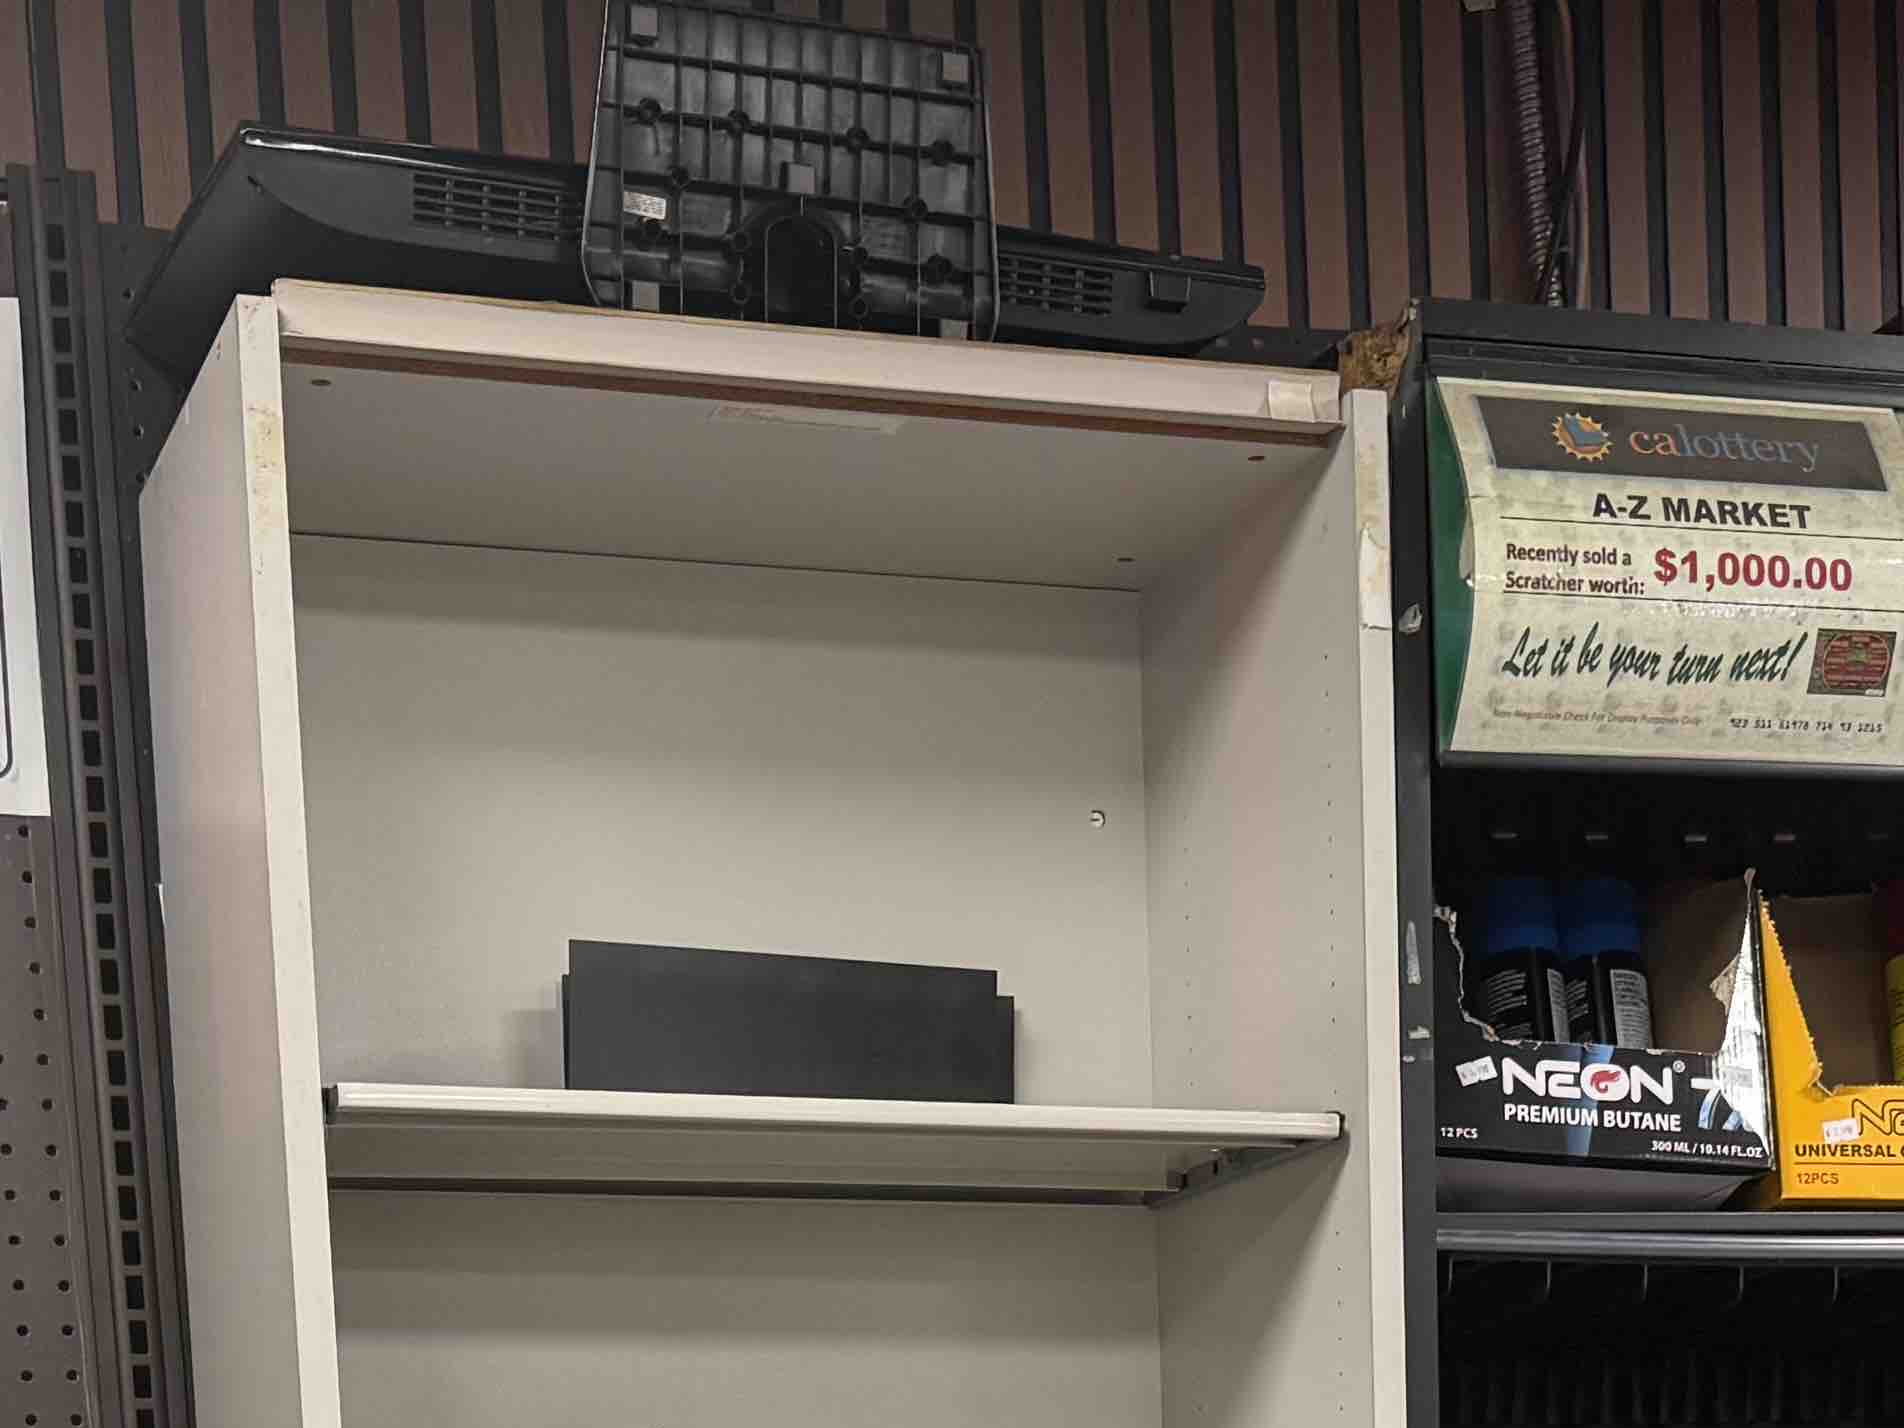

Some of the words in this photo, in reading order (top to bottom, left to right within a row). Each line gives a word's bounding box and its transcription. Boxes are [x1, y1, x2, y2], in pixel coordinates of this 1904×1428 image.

[1630, 423, 1819, 473] calottery
[1593, 494, 1651, 519] A-Z
[1663, 497, 1810, 528] MARKET
[1506, 544, 1579, 566] Recently
[1583, 548, 1617, 566] sold
[1654, 548, 1852, 591] $1,000.00
[1506, 573, 1584, 593] Scratcher
[1589, 578, 1645, 595] worth:
[1501, 626, 1548, 678] Let
[1551, 636, 1571, 676] it
[1577, 622, 1601, 674] be
[1603, 642, 1661, 687] your
[1667, 645, 1719, 685] turn
[1729, 632, 1808, 683] next!
[1502, 1057, 1673, 1104] NEON
[1504, 1104, 1597, 1127] PREMIUM
[1603, 1110, 1681, 1132] BUTANE
[1795, 1145, 1896, 1158] UNIVERSAL
[1796, 1173, 1838, 1184] 12PCS
